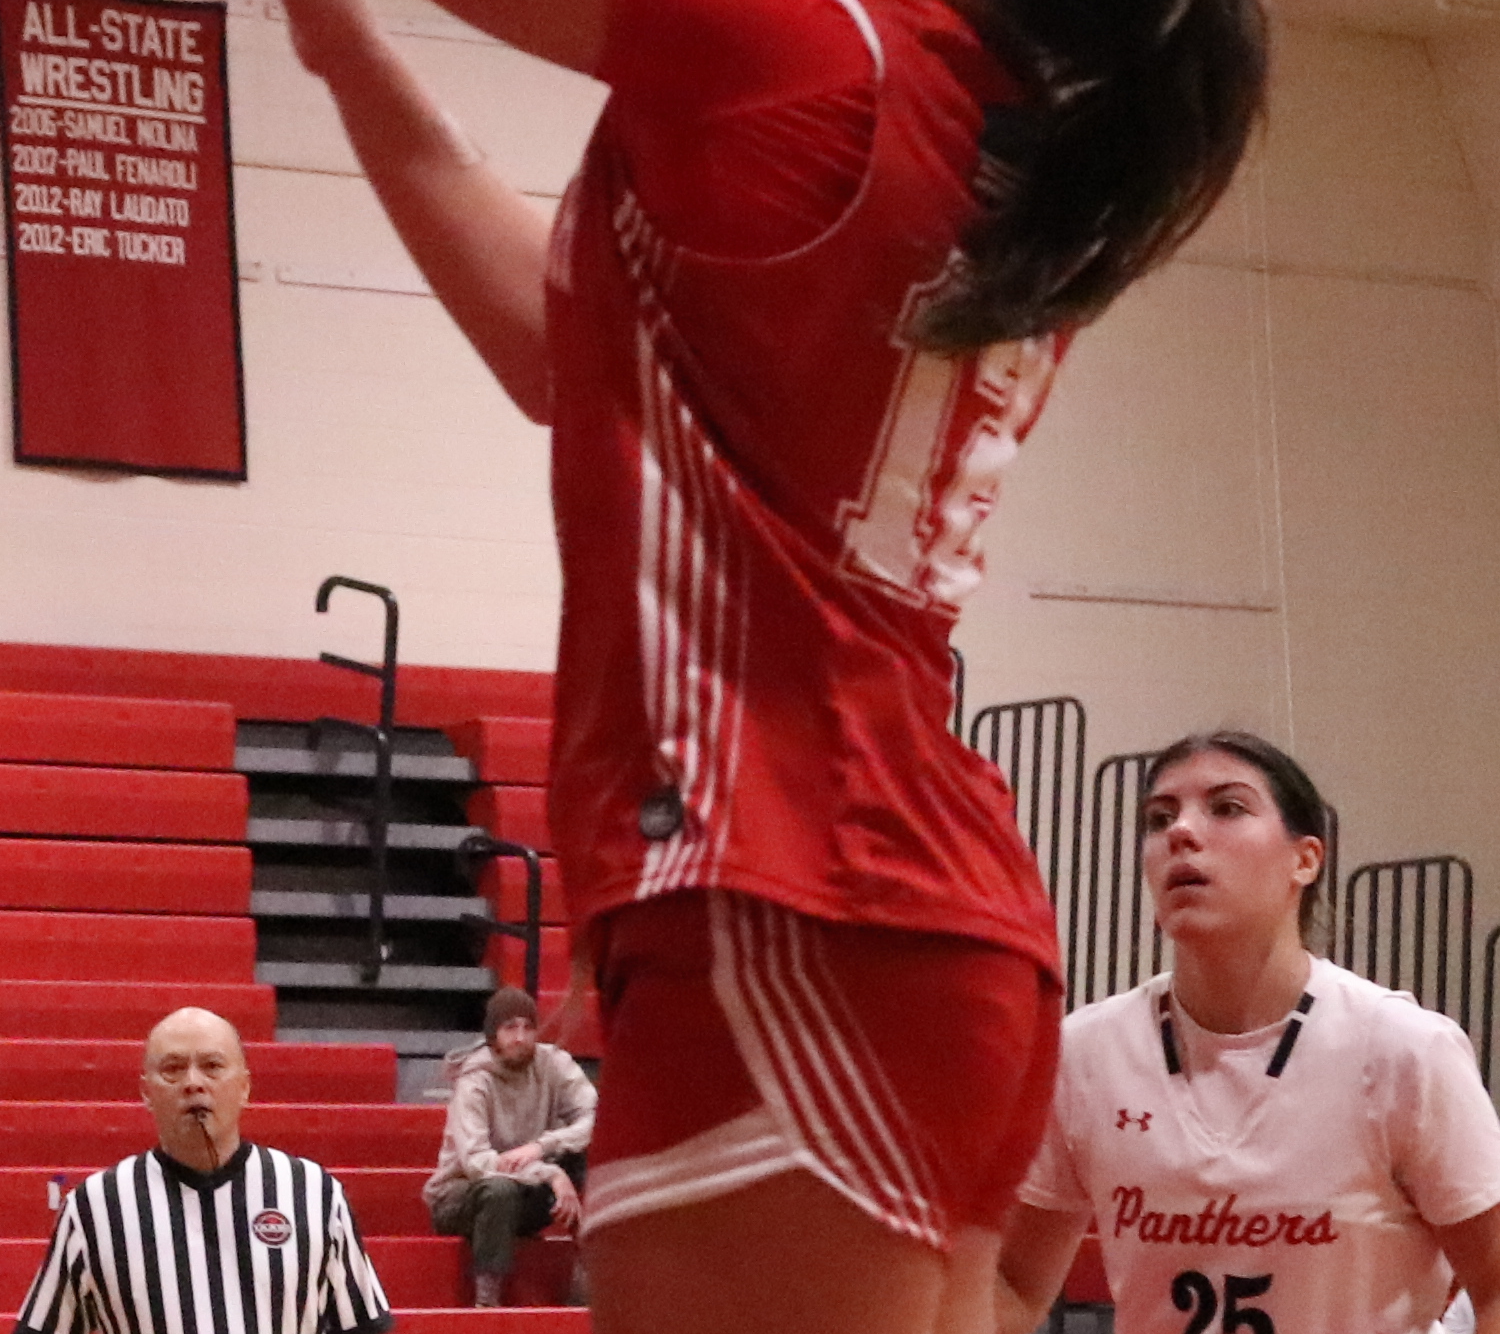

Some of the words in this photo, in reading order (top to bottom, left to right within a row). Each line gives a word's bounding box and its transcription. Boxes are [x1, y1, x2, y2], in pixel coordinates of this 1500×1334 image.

[23, 2, 203, 63] ALL-STATE
[21, 52, 203, 113] WRESTLING
[15, 183, 102, 217] 2012-RAY
[19, 223, 110, 256] 2012-ERIC
[116, 231, 185, 264] TUCKER
[1111, 1185, 1340, 1247] Panthers
